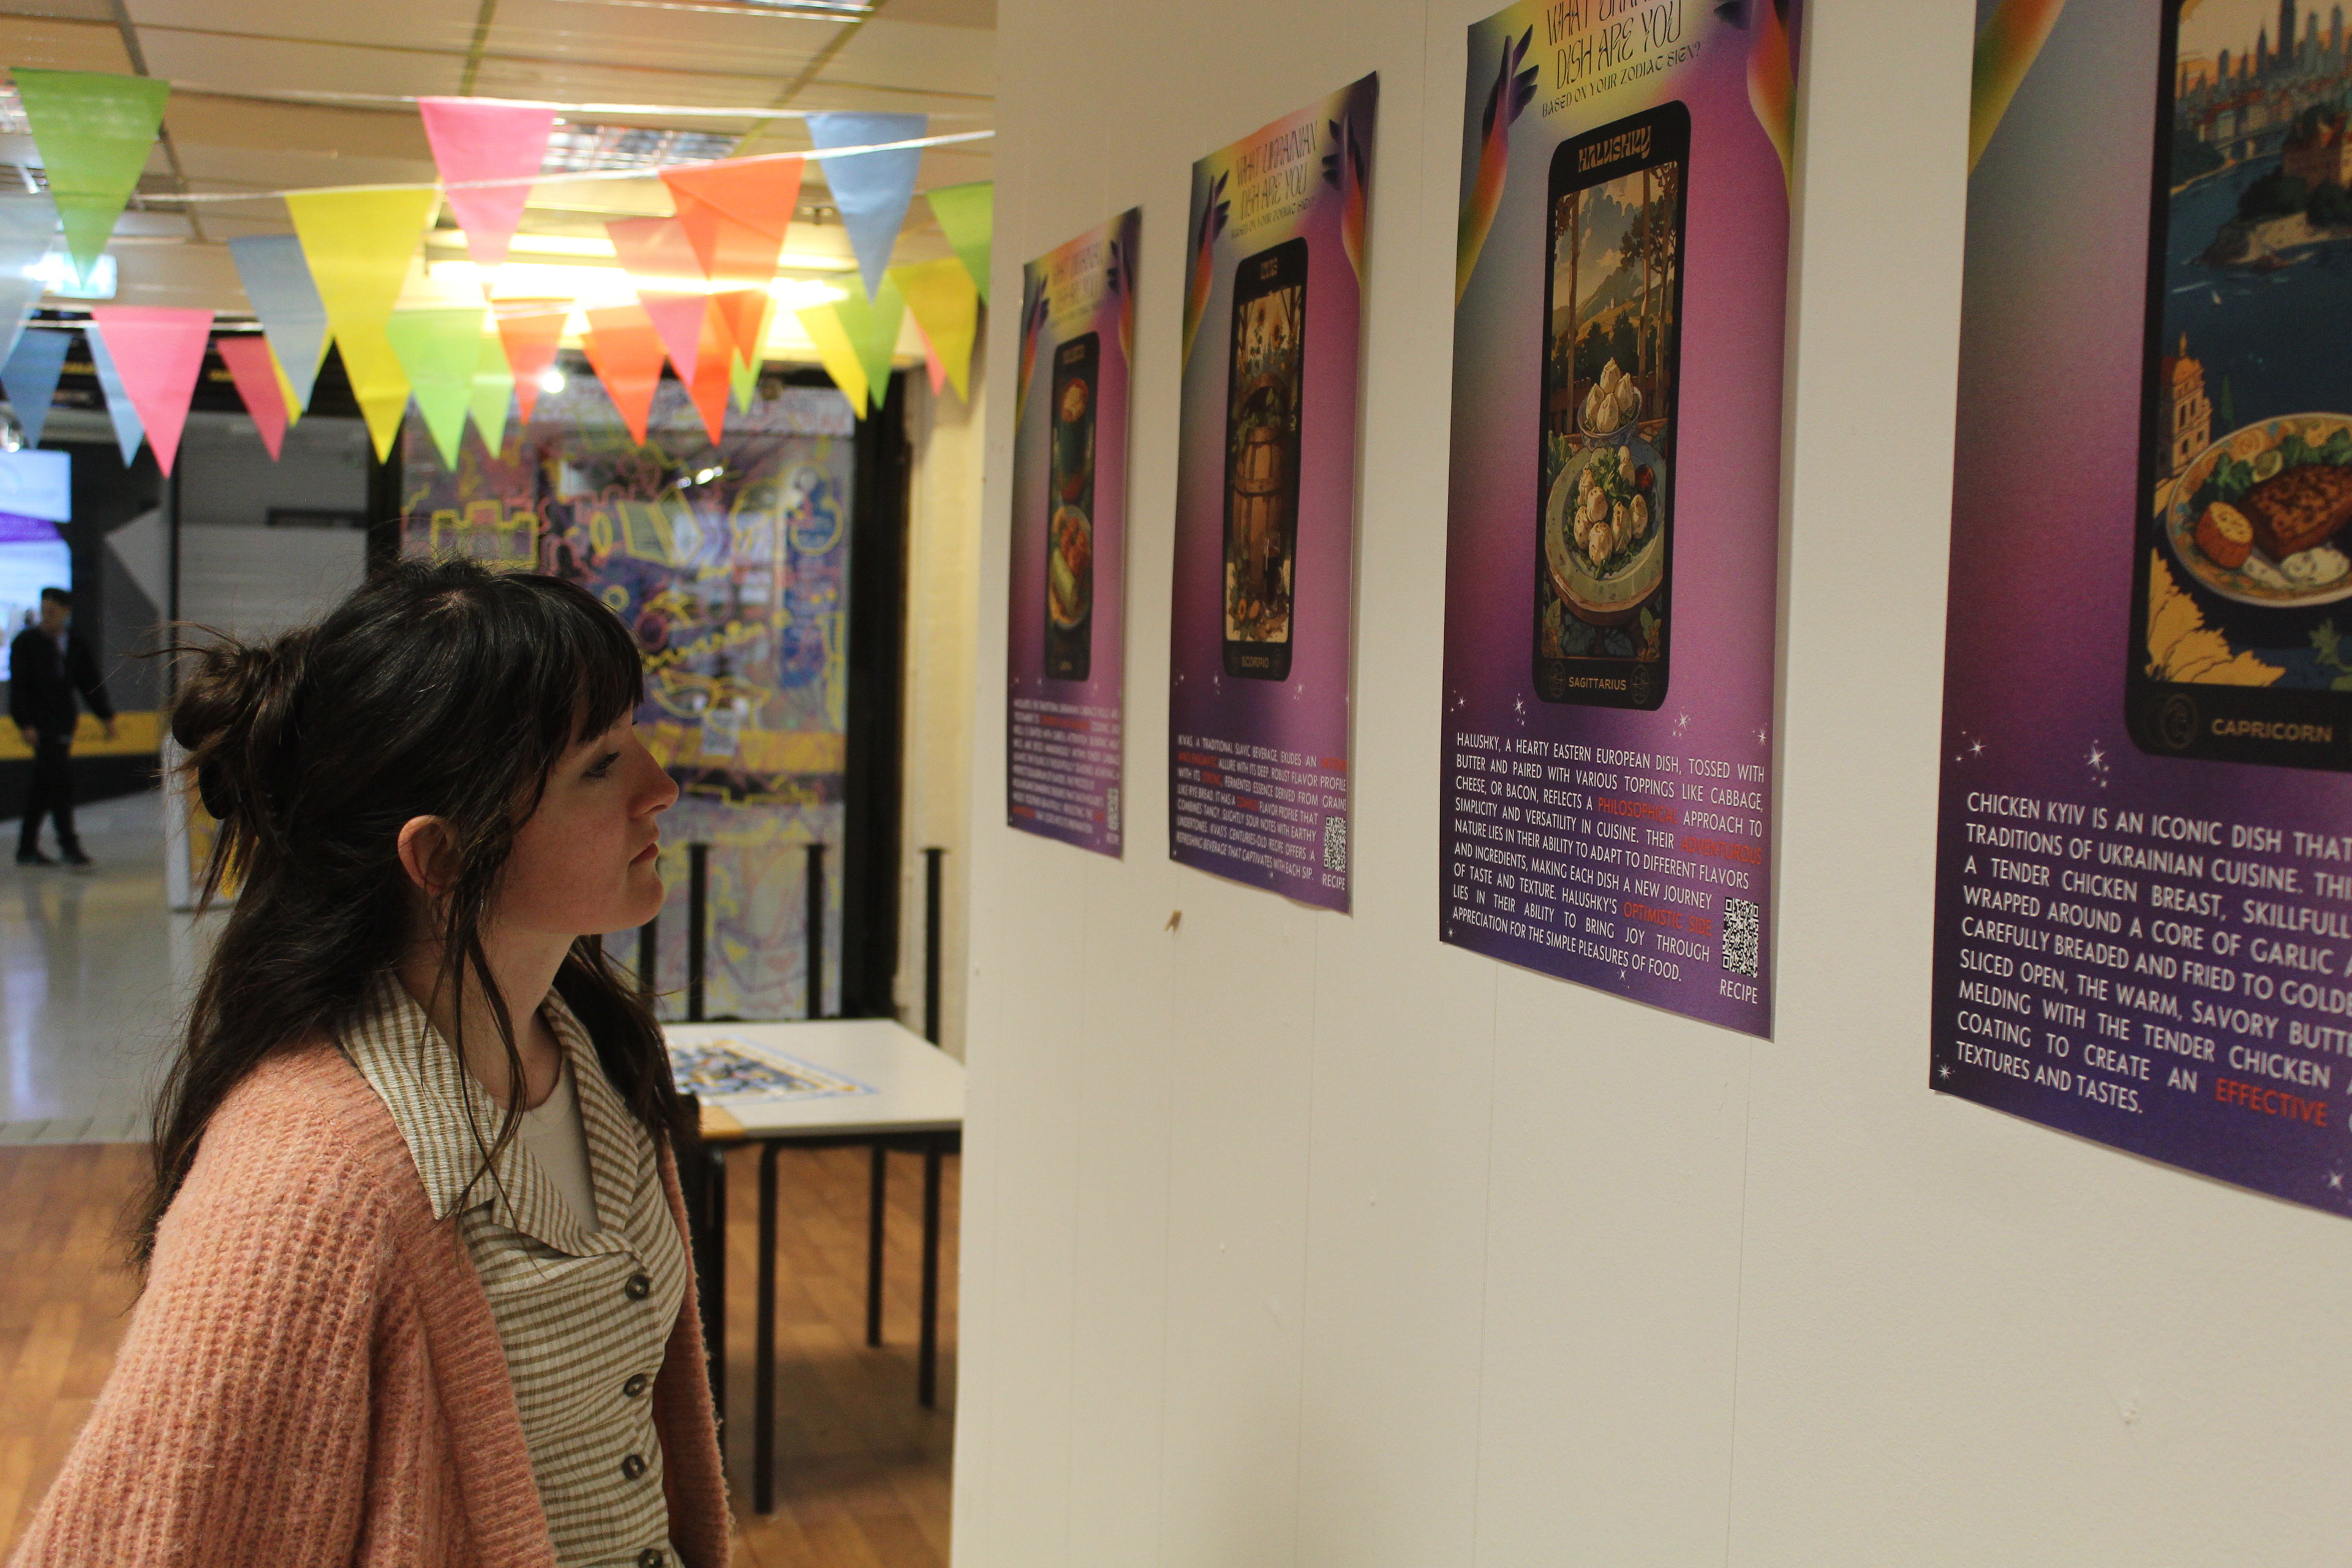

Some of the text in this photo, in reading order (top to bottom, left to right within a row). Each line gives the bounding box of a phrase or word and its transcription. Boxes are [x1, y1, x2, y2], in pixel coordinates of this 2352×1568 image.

[1557, 0, 1681, 89] DISH ARE YOU
[1542, 40, 1702, 118] BASED ON YOUR ZODIAC SIGN?
[1286, 162, 1307, 200] YOU
[1578, 125, 1651, 173] HALUSHKY
[1242, 655, 1269, 669] SCORPIO
[1569, 676, 1627, 691] SAGITTARIUS
[1281, 751, 1301, 765] EXUDES
[1306, 755, 1316, 767] AN
[1457, 732, 1763, 782] HALUSHKY, A HEARTY EASTERN EUROPEAN DISH, TOSSED WITH
[2211, 718, 2334, 744] CAPRICORN
[1259, 801, 1278, 816] FLAVOR
[1279, 805, 1297, 820] PROFILE
[1300, 810, 1318, 824] THAT
[1292, 771, 1346, 792] FLAVOR PROFILE
[1298, 790, 1346, 811] FROM GRAINS
[1455, 775, 1762, 837] CHEESE, OR BACON, REFLECTS A PHILOSOPHICAL APPROACH TO
[1456, 753, 1764, 813] BUTTER AND PAIRED WITH VARIOUS TOPPINGS LIKE CABBAGE,
[1286, 843, 1315, 861] OFFERS A
[1291, 826, 1316, 843] EARTHY
[1455, 796, 1763, 866] SIMPLICITY AND VERSATILITY IN CUISINE. THEIR ADVENTUROUS
[1455, 818, 1748, 889] NATURE LIES IN THEIR ABILITY TO ADAPT TO DIFFERENT FLAVORS
[1967, 791, 2352, 862] CHICKEN KYIV IS AN ICONIC DISH THAT
[1286, 861, 1313, 881] EACH SIP.
[1322, 872, 1345, 891] RECIPE
[1454, 842, 1712, 910] AND INGREDIENTS, MAKING EACH DISH A NEW JOURNEY
[1966, 823, 2352, 900] TRADITIONS OF UKRAINIAN CUISINE. THI
[1453, 862, 1711, 936] OF TASTE AND TEXTURE. HALUSHKY'S OPTIMISTIC SIDE
[1453, 883, 1709, 962] LIES IN THEIR ABILITY TO BRING JOY THROUGH
[1963, 884, 2040, 917] WRAPPED
[2047, 902, 2121, 933] AROUND
[2129, 917, 2142, 938] A
[2151, 919, 2203, 950] CORE
[2212, 931, 2241, 956] OF
[2250, 938, 2332, 974] GARLIC
[1964, 854, 2352, 939] A TENDER CHICKEN BREAST, SKILLFULL
[1452, 906, 1681, 981] APPRECIATION FOR THE SIMPLE PLEASURES OF FOOD.
[1961, 916, 2049, 951] CAREFULLY
[2054, 934, 2128, 968] BREADED
[2134, 952, 2176, 979] AND
[2182, 960, 2234, 991] FRIED
[2242, 972, 2272, 999] TO
[1719, 978, 1758, 1005] RECIPE
[1960, 948, 2013, 977] SLICED
[2020, 961, 2068, 994] OPEN,
[2076, 973, 2108, 1001] THE
[2116, 983, 2182, 1020] WARM,
[2192, 1000, 2278, 1038] SAVORY
[1958, 979, 2030, 1014] MELDING
[2043, 998, 2086, 1028] WITH
[2097, 1012, 2130, 1040] THE
[2143, 1023, 2214, 1061] TENDER
[2229, 1045, 2329, 1087] CHICKEN
[1956, 1040, 2142, 1113] TEXTURES AND TASTES.
[1957, 1010, 2030, 1047] COATING
[2046, 1033, 2069, 1057] TO
[2084, 1044, 2150, 1080] CREATE
[2168, 1067, 2196, 1092] AN
[2215, 1077, 2326, 1126] EFFECTIVE
